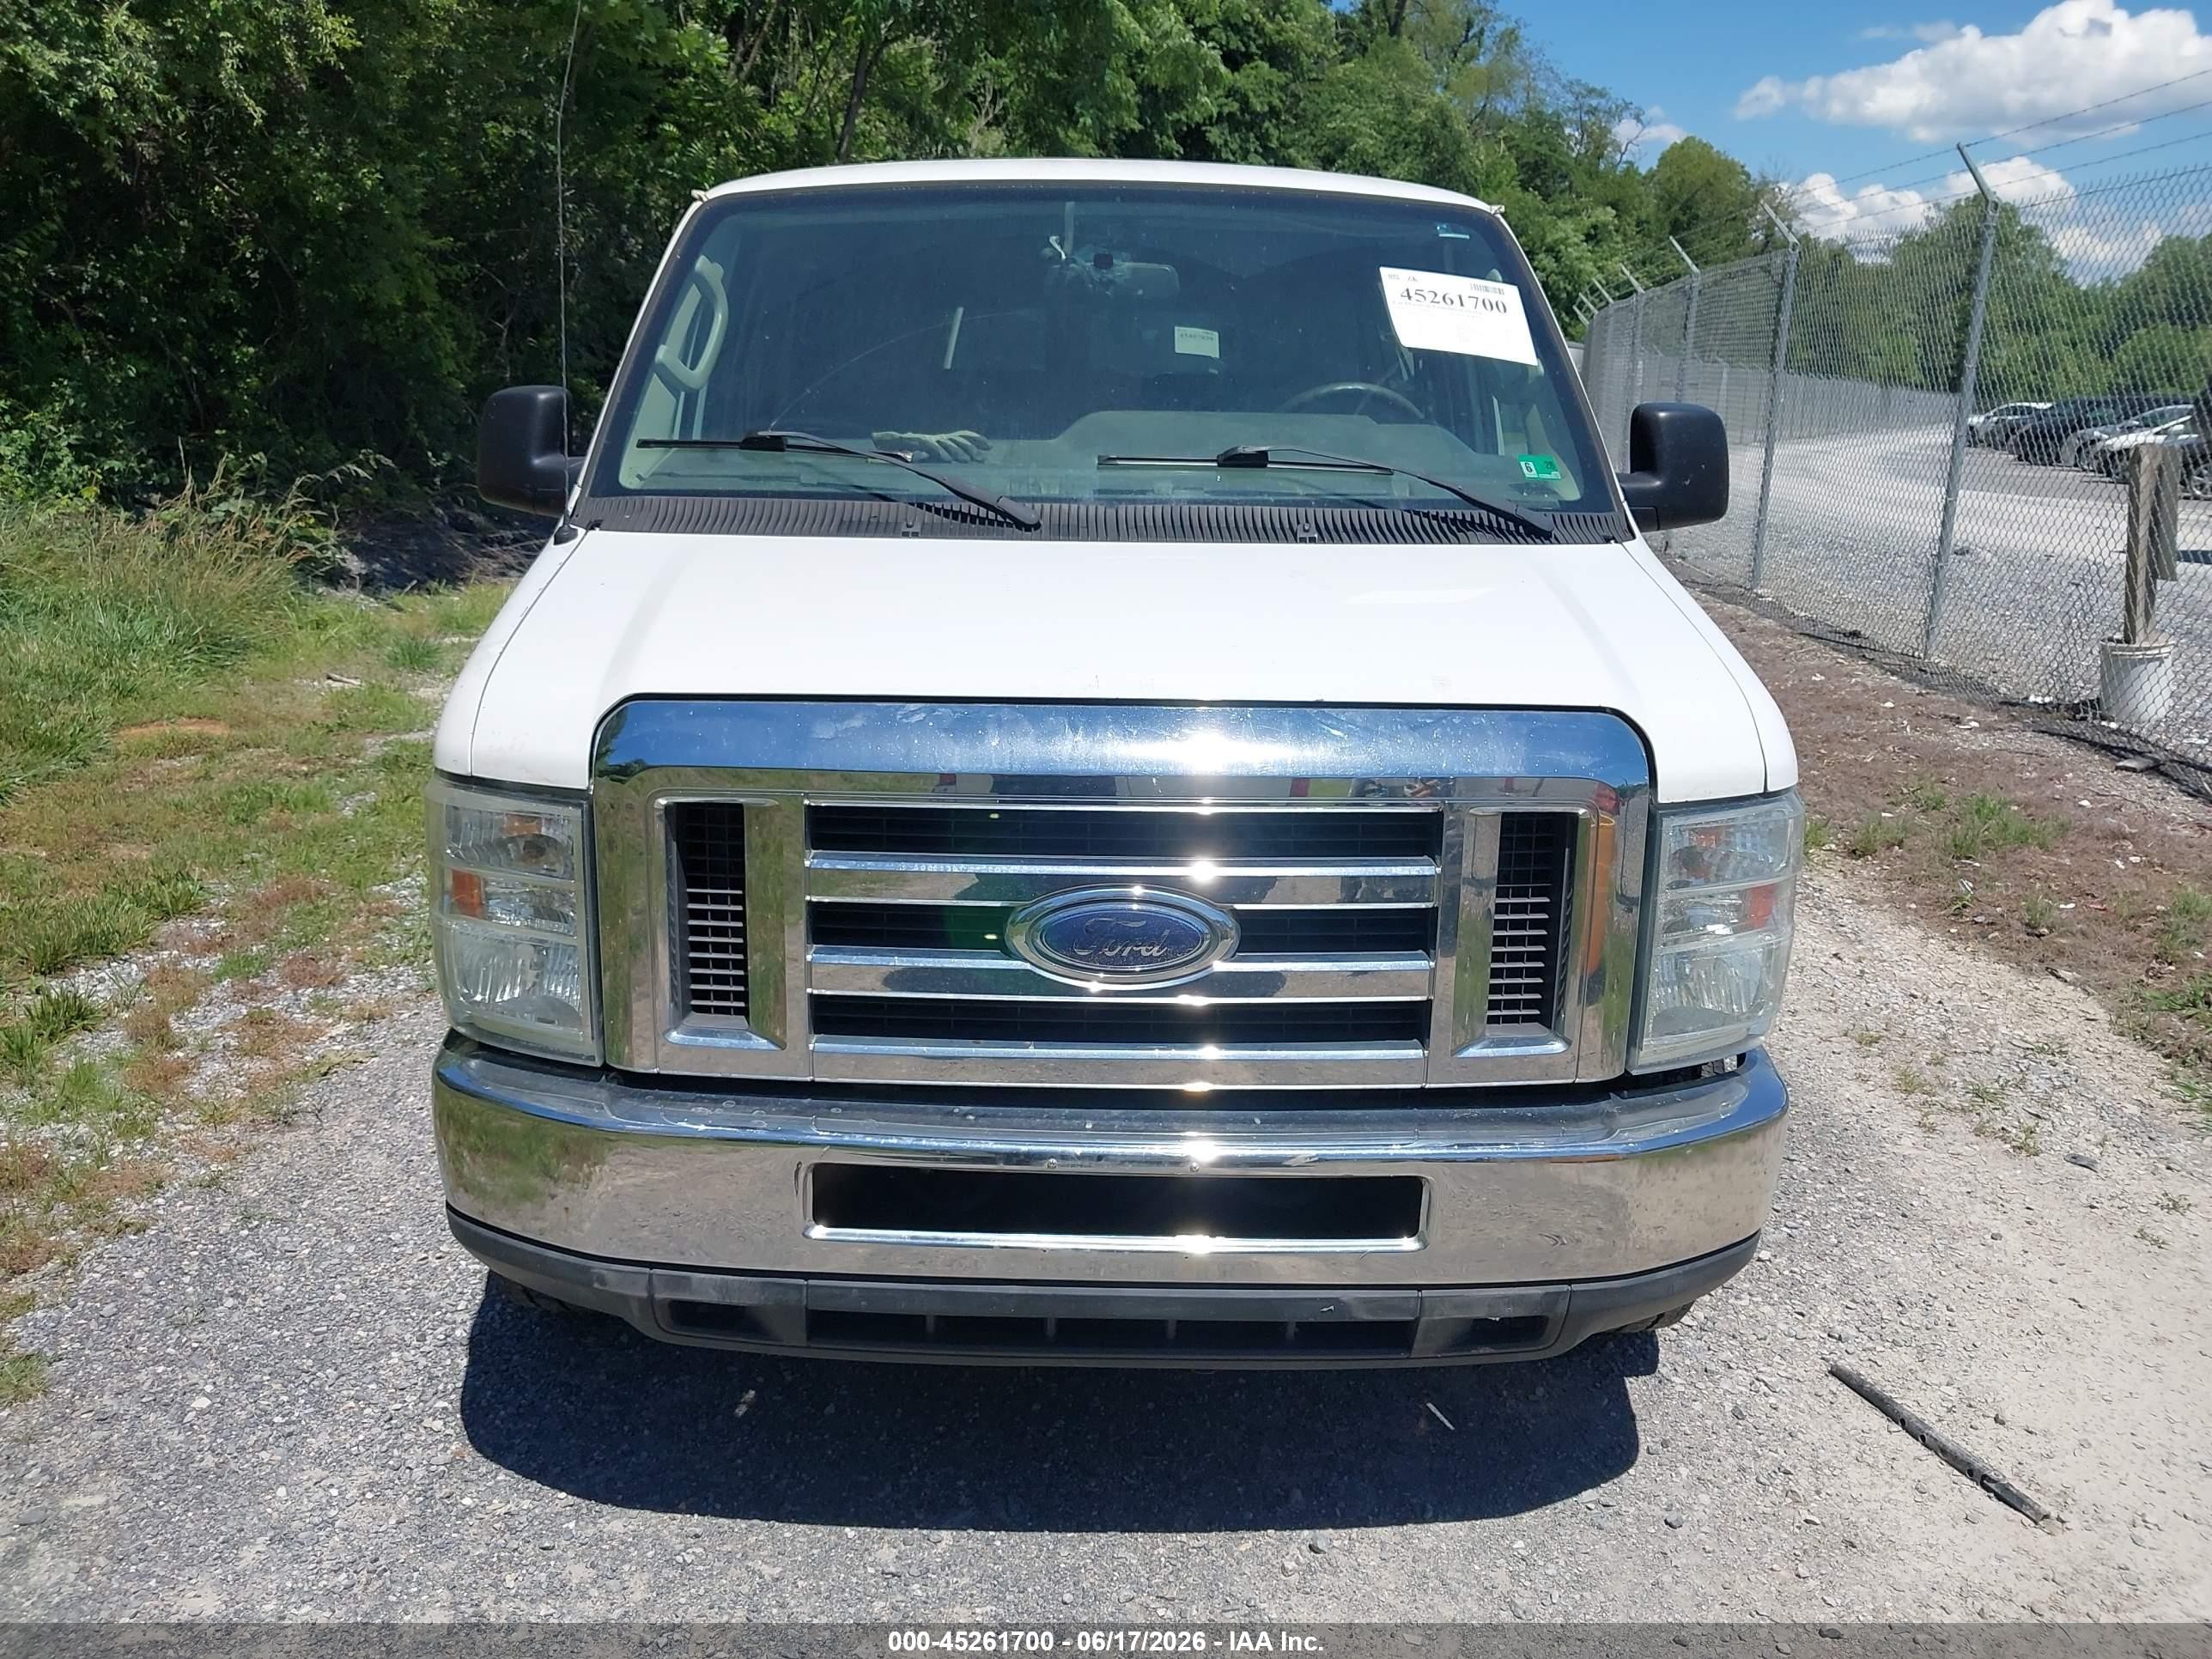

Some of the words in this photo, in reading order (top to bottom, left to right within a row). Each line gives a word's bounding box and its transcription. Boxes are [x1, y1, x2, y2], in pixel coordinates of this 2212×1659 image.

[1401, 288, 1508, 314] 45261700
[1524, 462, 1533, 473] 6
[1073, 917, 1170, 957] Ford
